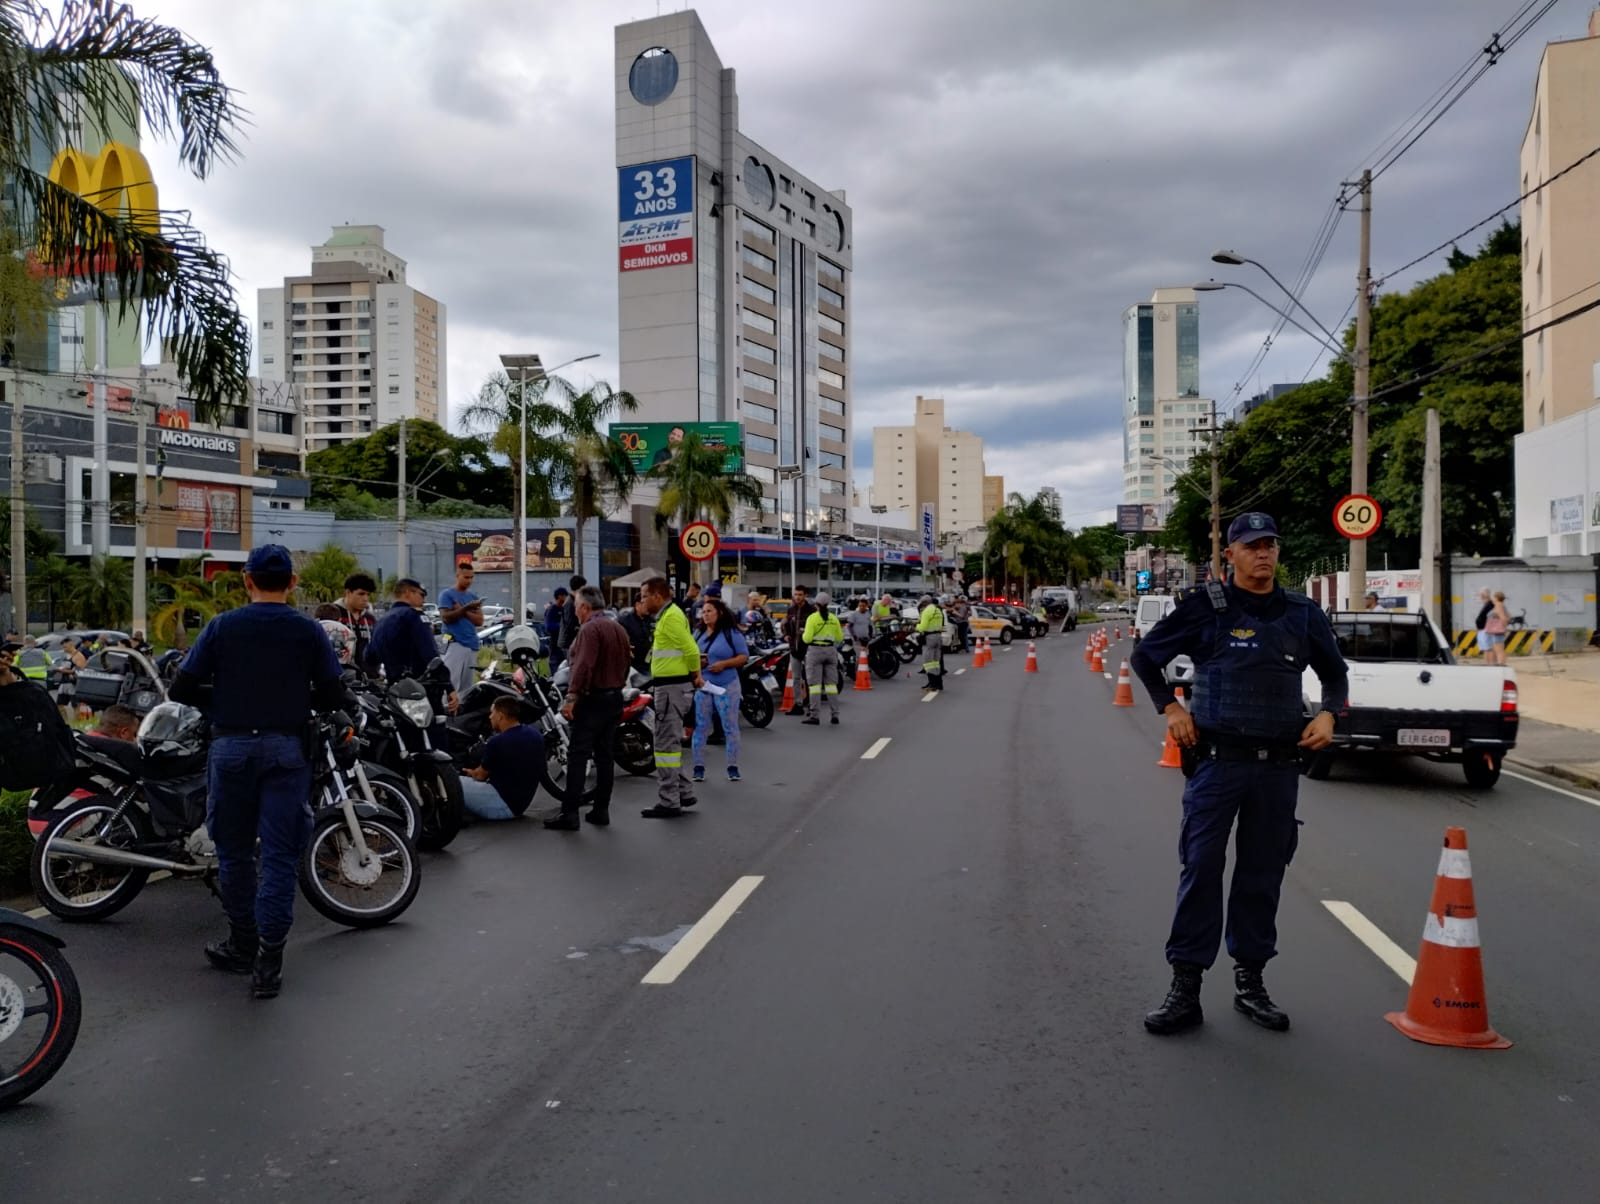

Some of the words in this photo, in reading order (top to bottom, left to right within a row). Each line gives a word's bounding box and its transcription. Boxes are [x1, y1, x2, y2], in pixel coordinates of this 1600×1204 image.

[634, 167, 677, 200] 33
[634, 198, 677, 215] ANOS
[623, 252, 688, 269] SEMINOVOS
[160, 430, 236, 453] McDonald's
[1342, 505, 1371, 524] 60
[687, 531, 710, 547] 60
